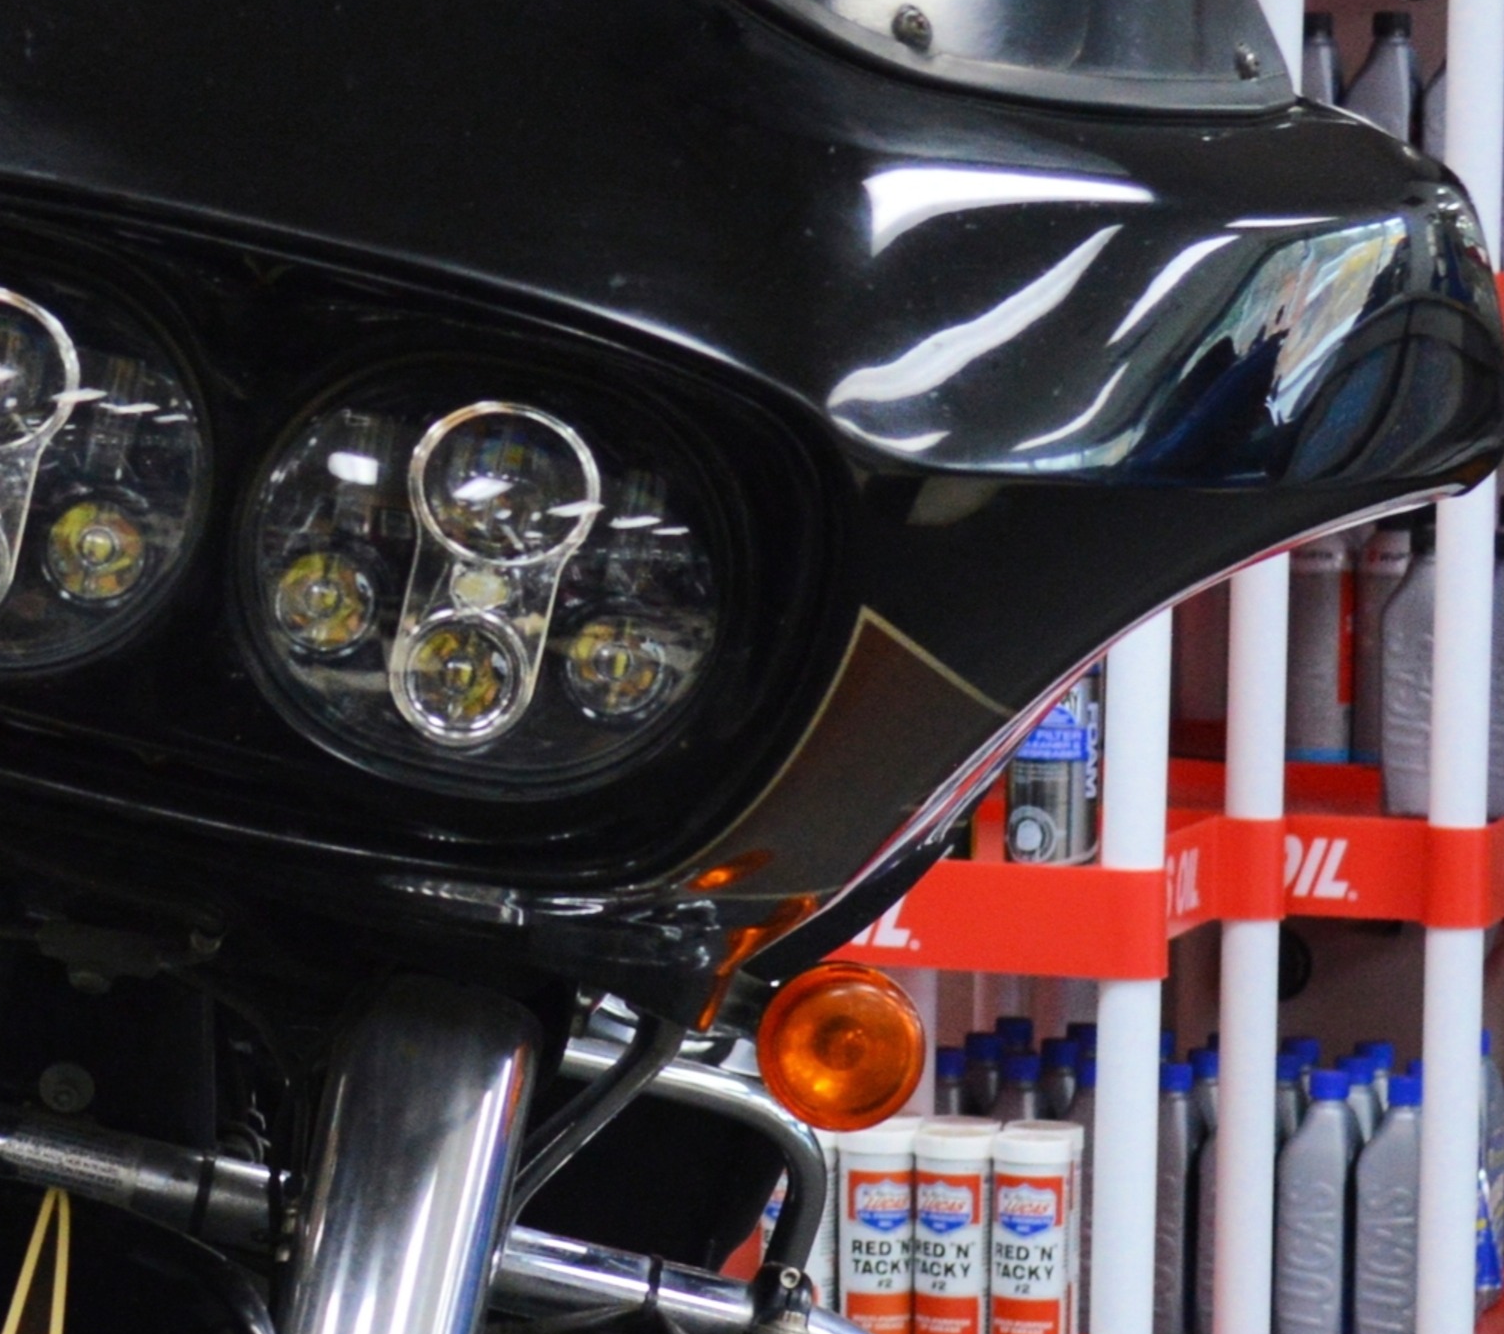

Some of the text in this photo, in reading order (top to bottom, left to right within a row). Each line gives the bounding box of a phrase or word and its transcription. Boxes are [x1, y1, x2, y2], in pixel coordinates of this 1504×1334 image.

[1035, 729, 1083, 741] FILTER
[1084, 701, 1100, 799] FOAM
[851, 1239, 892, 1255] RED
[914, 1241, 946, 1258] RED
[995, 1243, 1030, 1261] RED
[851, 1259, 913, 1275] TACKY
[913, 1261, 972, 1278] TACKY
[995, 1263, 1055, 1281] TACKY
[877, 1279, 893, 1289] #2
[931, 1281, 947, 1292] #2
[1014, 1283, 1030, 1295] #2
